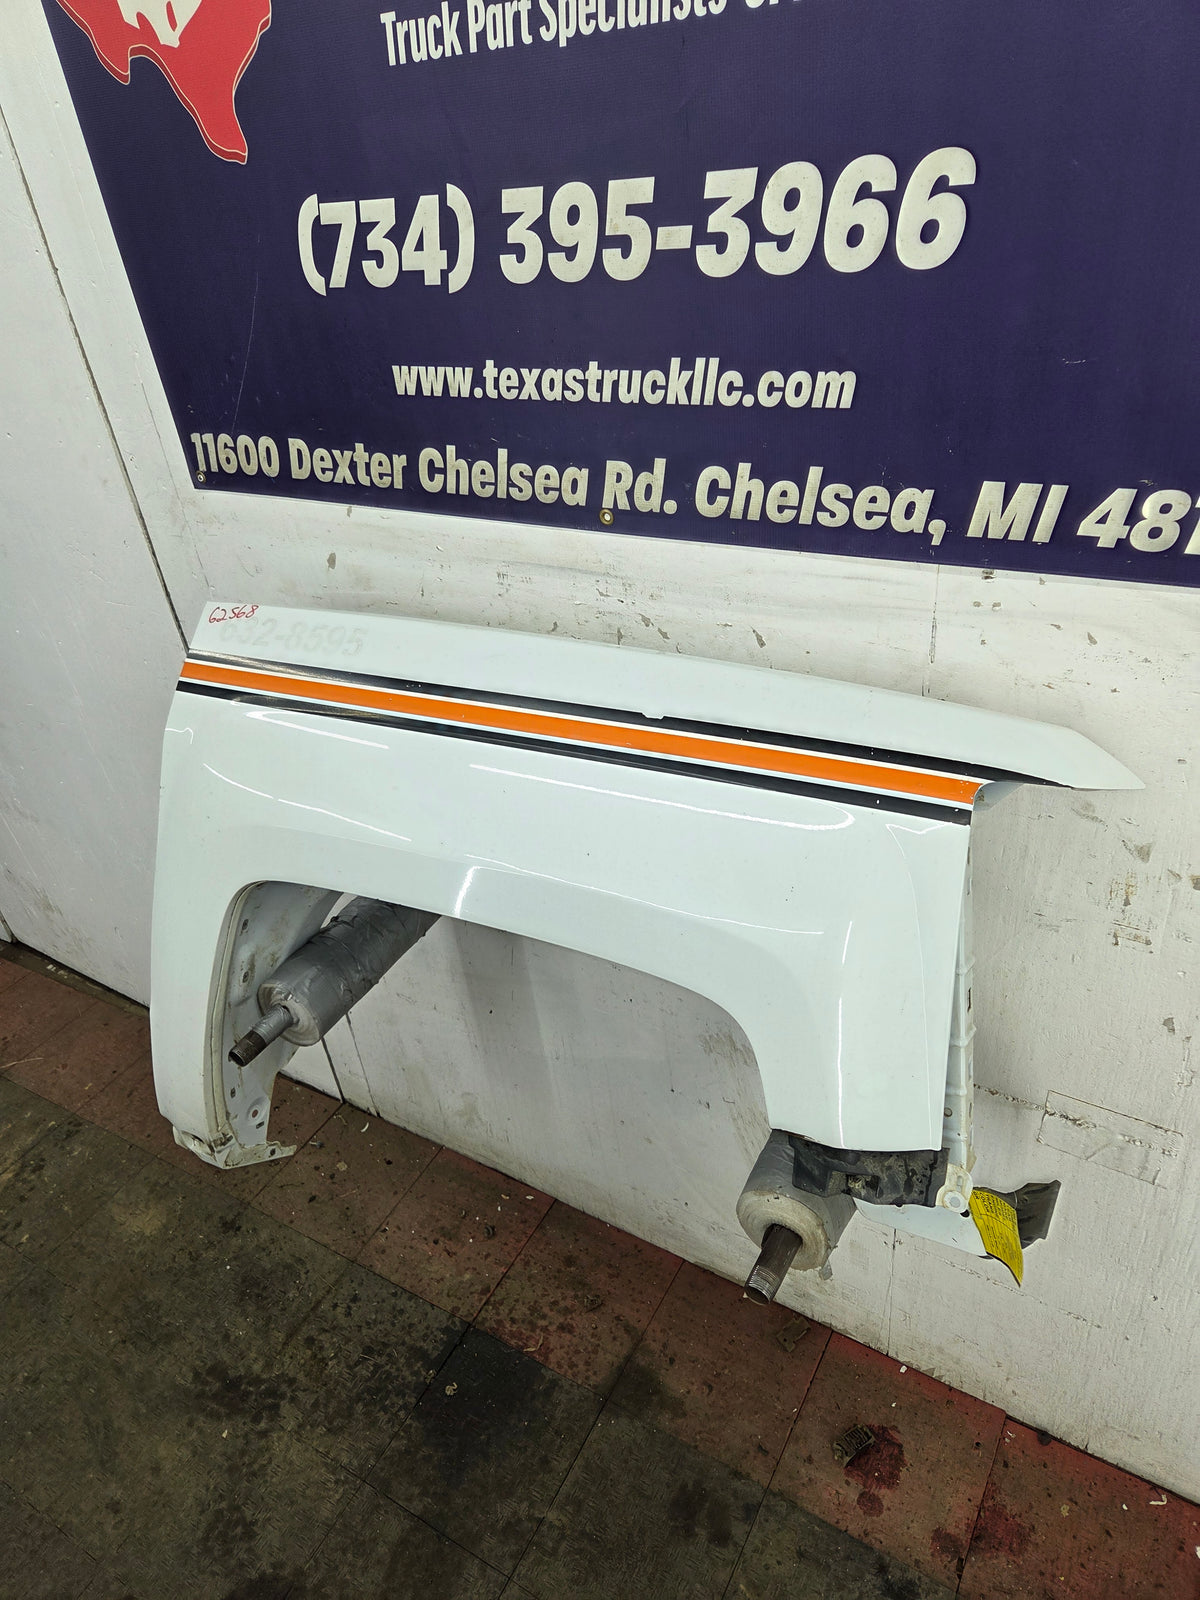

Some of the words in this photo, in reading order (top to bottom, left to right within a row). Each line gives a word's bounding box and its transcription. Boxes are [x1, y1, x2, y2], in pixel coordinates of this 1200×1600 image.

[380, 1, 464, 67] Truck
[466, 0, 533, 54] Part
[297, 182, 475, 297] (734)
[499, 146, 977, 285] 395-3966
[391, 357, 857, 409] www.texastruckllc.com
[190, 432, 280, 478] 11600
[287, 437, 407, 490] Dexter
[418, 444, 589, 507] Chelsea
[601, 457, 678, 515] Rd.
[694, 462, 947, 546] Chelsea,
[966, 480, 1070, 543] MI
[208, 604, 259, 624] 62568
